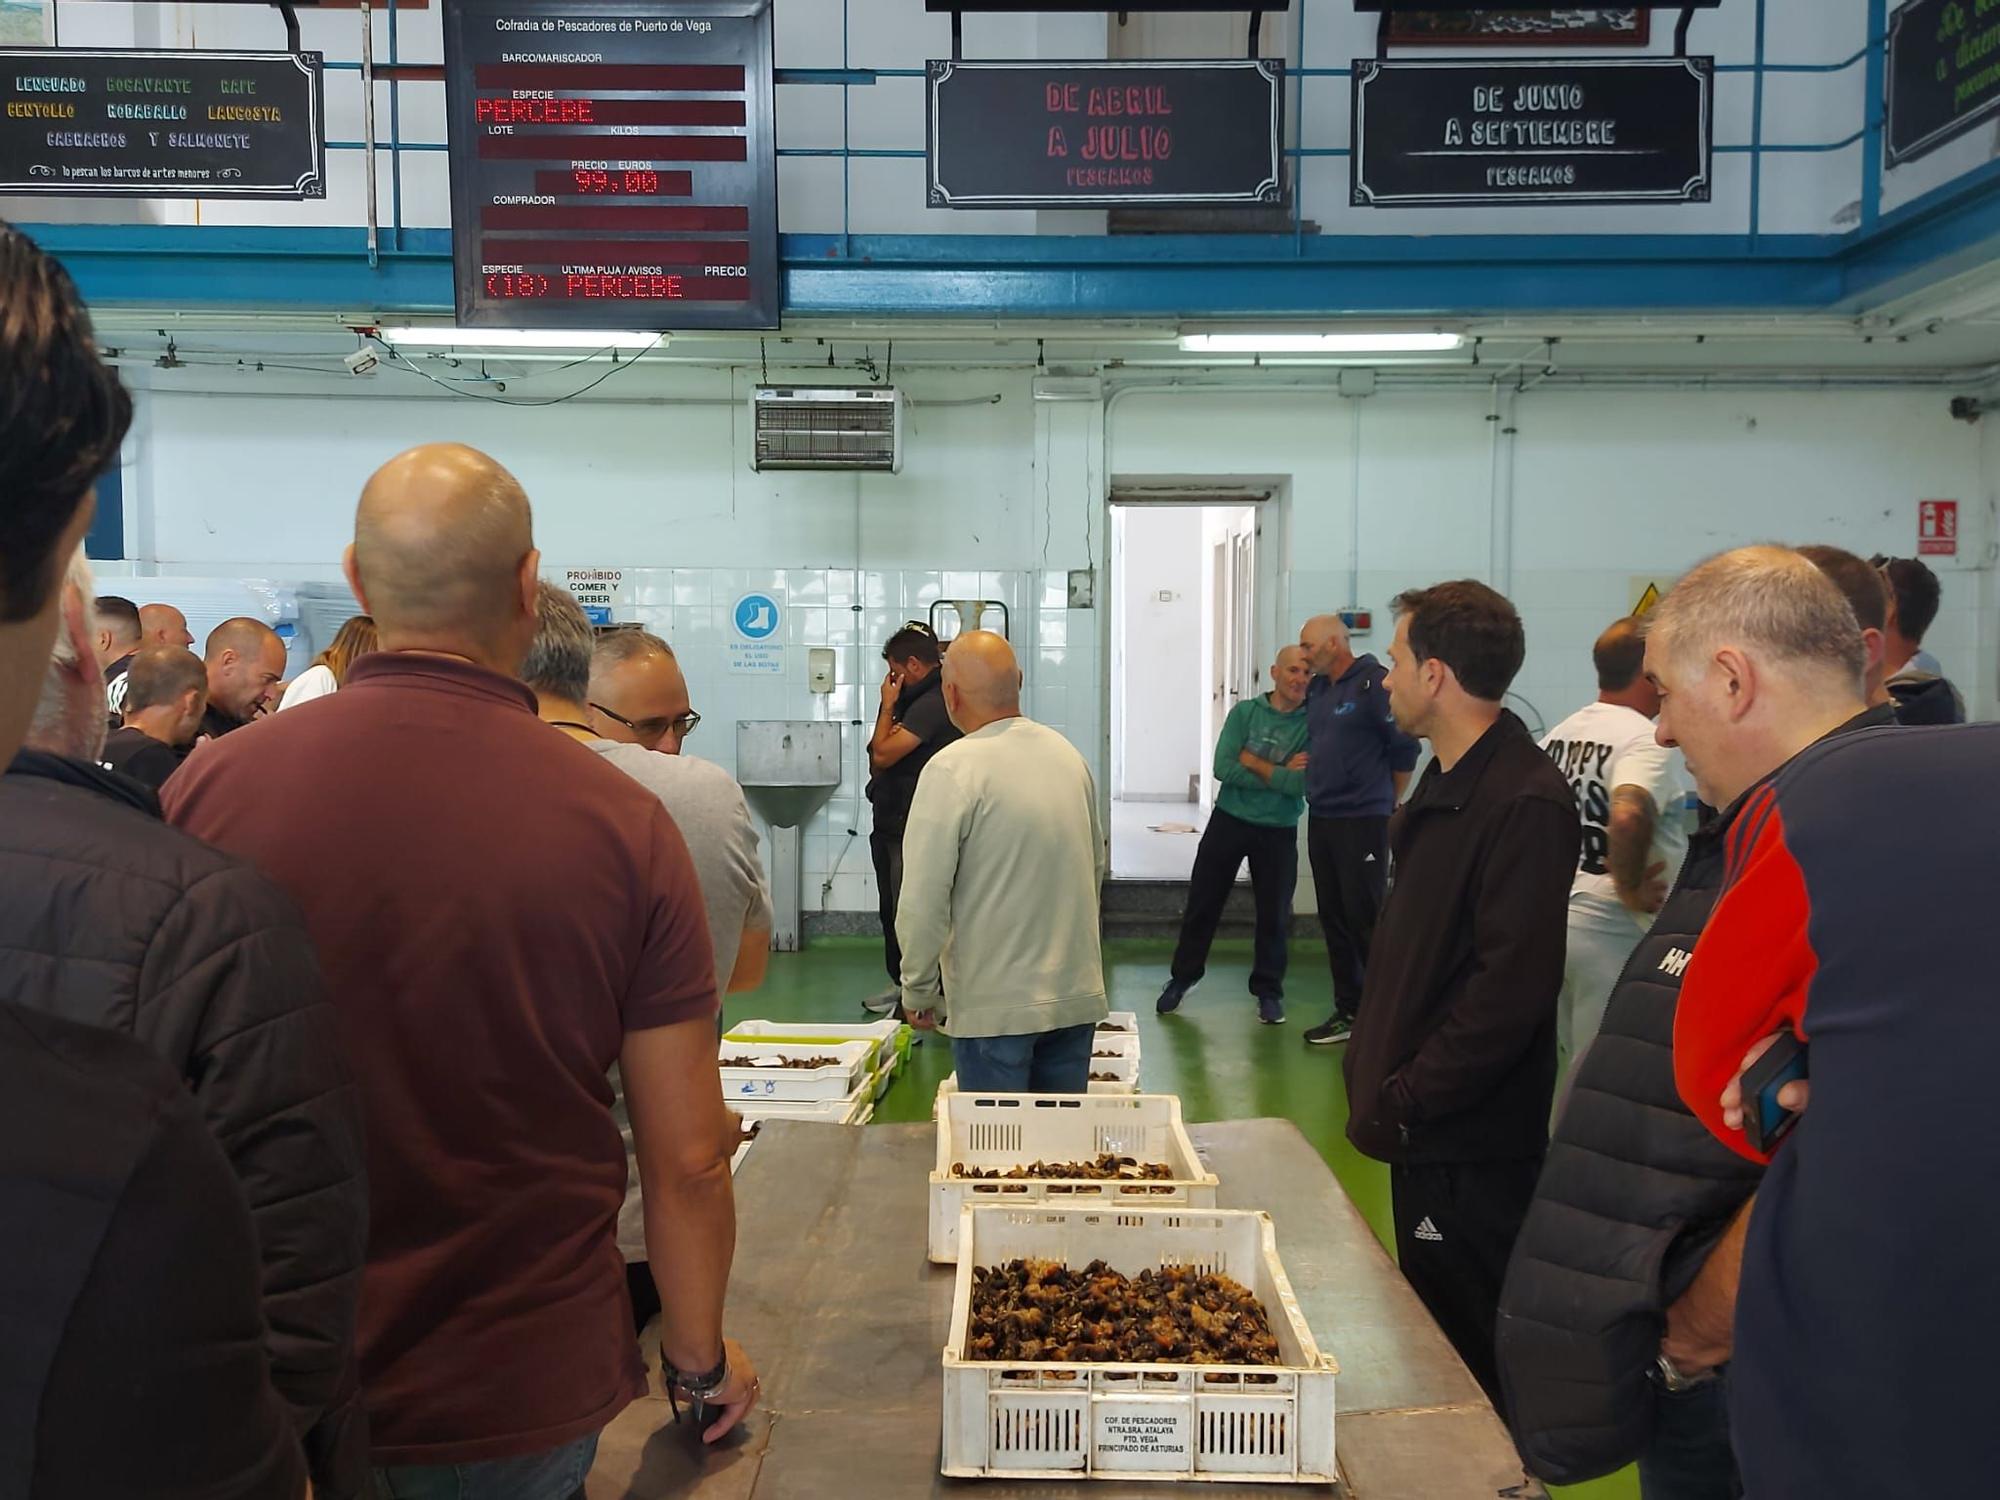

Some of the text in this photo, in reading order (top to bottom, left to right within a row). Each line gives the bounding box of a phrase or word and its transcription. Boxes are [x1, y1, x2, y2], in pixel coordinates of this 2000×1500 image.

[542, 19, 555, 32] de
[557, 20, 617, 32] Pescadores
[619, 20, 633, 32] de
[635, 20, 668, 33] Puerto
[670, 20, 684, 33] de
[685, 20, 712, 34] Vega
[502, 53, 603, 63] BARCO/MARISCADOR
[15, 76, 257, 95] LENGUADO BOGAVANTE RAPE
[512, 90, 555, 100] ESPECIE
[1046, 82, 1173, 116] DE ABRIL
[1472, 83, 1585, 112] DE JUNIO
[7, 102, 282, 122] CENTOLLO RODABALLO LANGOSTA
[477, 99, 594, 122] PERCEBE
[488, 125, 514, 135] LOTE
[610, 126, 640, 136] KILOS
[1443, 117, 1617, 146] A SEPTIEMBRE
[46, 131, 251, 149] CABRACHOS Y SALMONETE
[1046, 124, 1173, 160] A JULIO
[571, 160, 653, 171] PRECIO EUROS
[71, 166, 99, 180] pescan
[100, 165, 112, 177] los
[113, 165, 141, 178] barcos
[142, 166, 151, 178] de
[152, 166, 177, 179] artes
[177, 168, 211, 179] menores
[1066, 167, 1154, 187] PESCAMOS
[1486, 165, 1577, 187] PESCAMOS
[493, 195, 556, 205] COMPRADOR
[482, 265, 524, 275] ESPECIE
[561, 265, 596, 275] ULTIMA
[597, 266, 621, 276] PUJA
[628, 266, 663, 276] AVISOS
[704, 266, 747, 277] PRECIO
[487, 274, 683, 298] (18) PERCEBE
[566, 571, 622, 580] PROHIBIDO
[570, 583, 620, 591] COMER Y
[577, 595, 610, 604] BEBER
[1104, 1416, 1178, 1425] COF. DE PESCADORES
[1144, 1426, 1174, 1434] ATALAYA
[1123, 1435, 1138, 1443] PTO.
[1098, 1444, 1185, 1453] PRINCIPADO DE ASTURIAS
